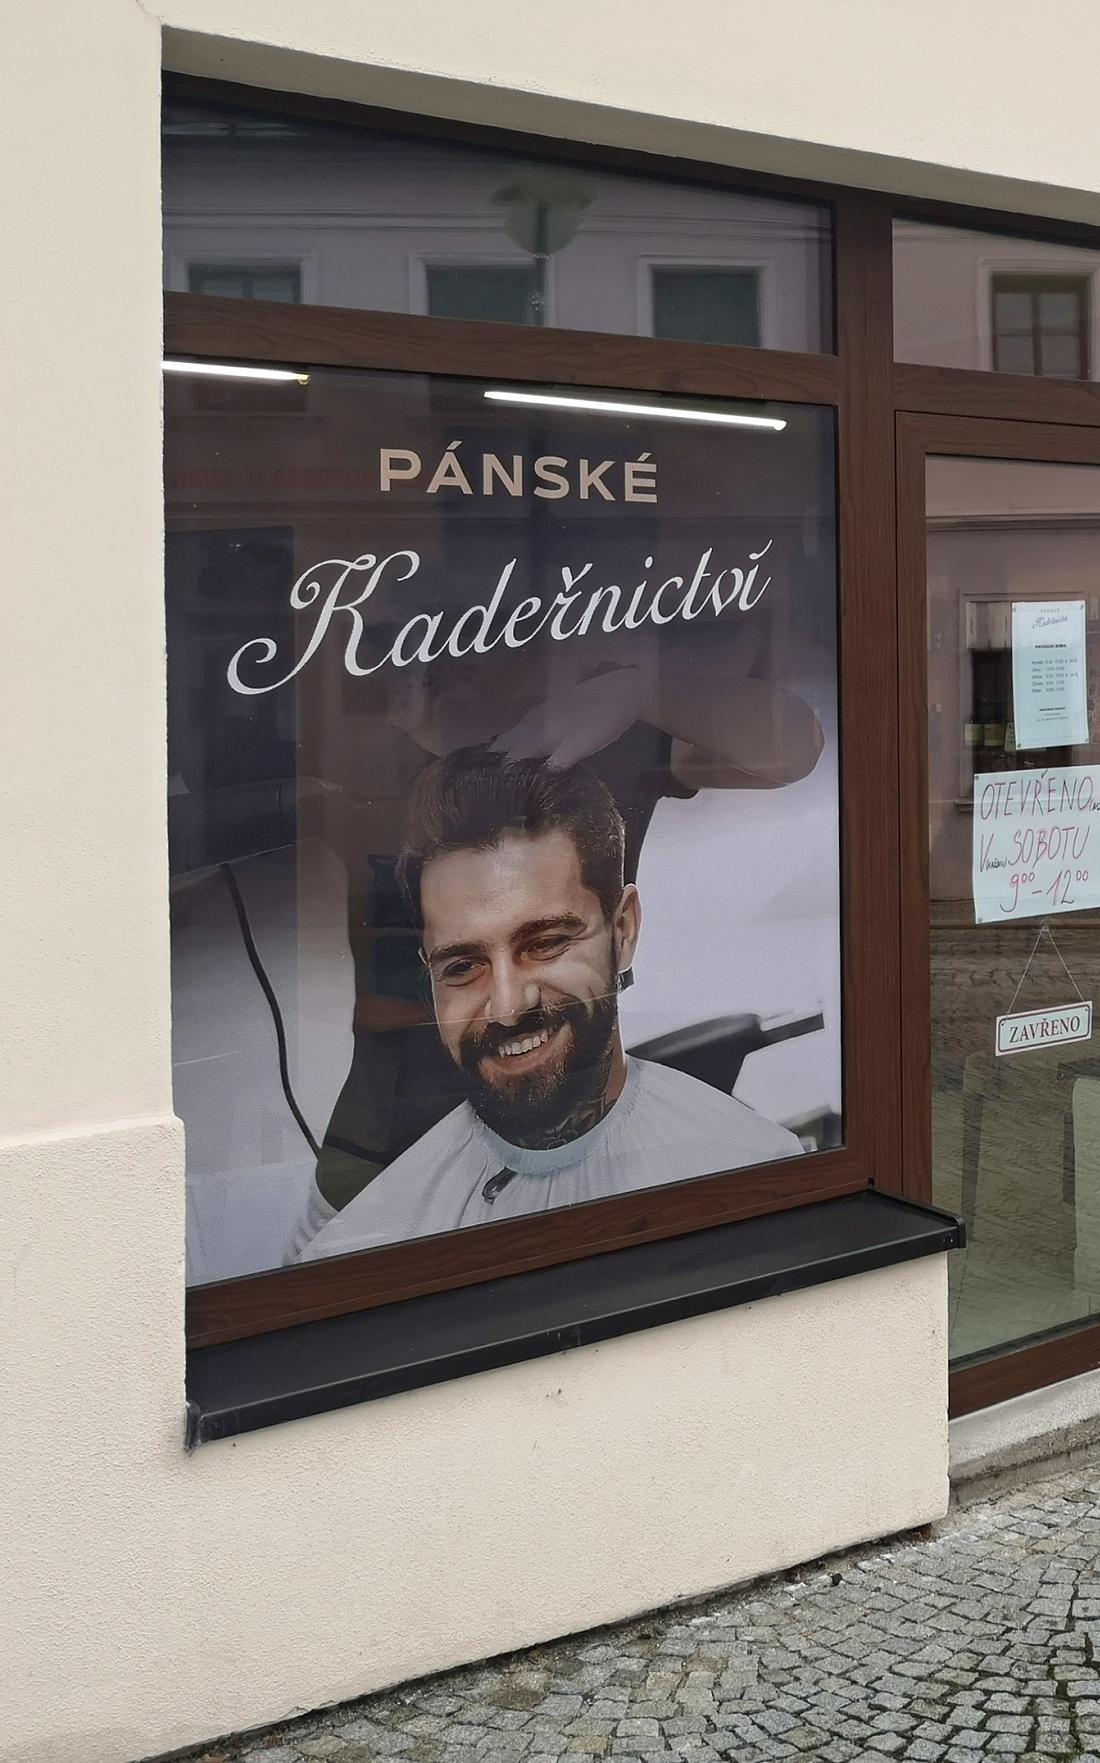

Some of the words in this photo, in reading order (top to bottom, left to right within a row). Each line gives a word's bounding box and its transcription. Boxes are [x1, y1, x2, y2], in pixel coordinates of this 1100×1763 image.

[380, 440, 658, 503] PÁNSKÉ
[226, 539, 774, 695] Kadeřnictví
[980, 768, 1094, 820] OTEVŘENO
[1008, 825, 1091, 868] SOBOTU
[1009, 1015, 1080, 1043] ZAVŘENO
